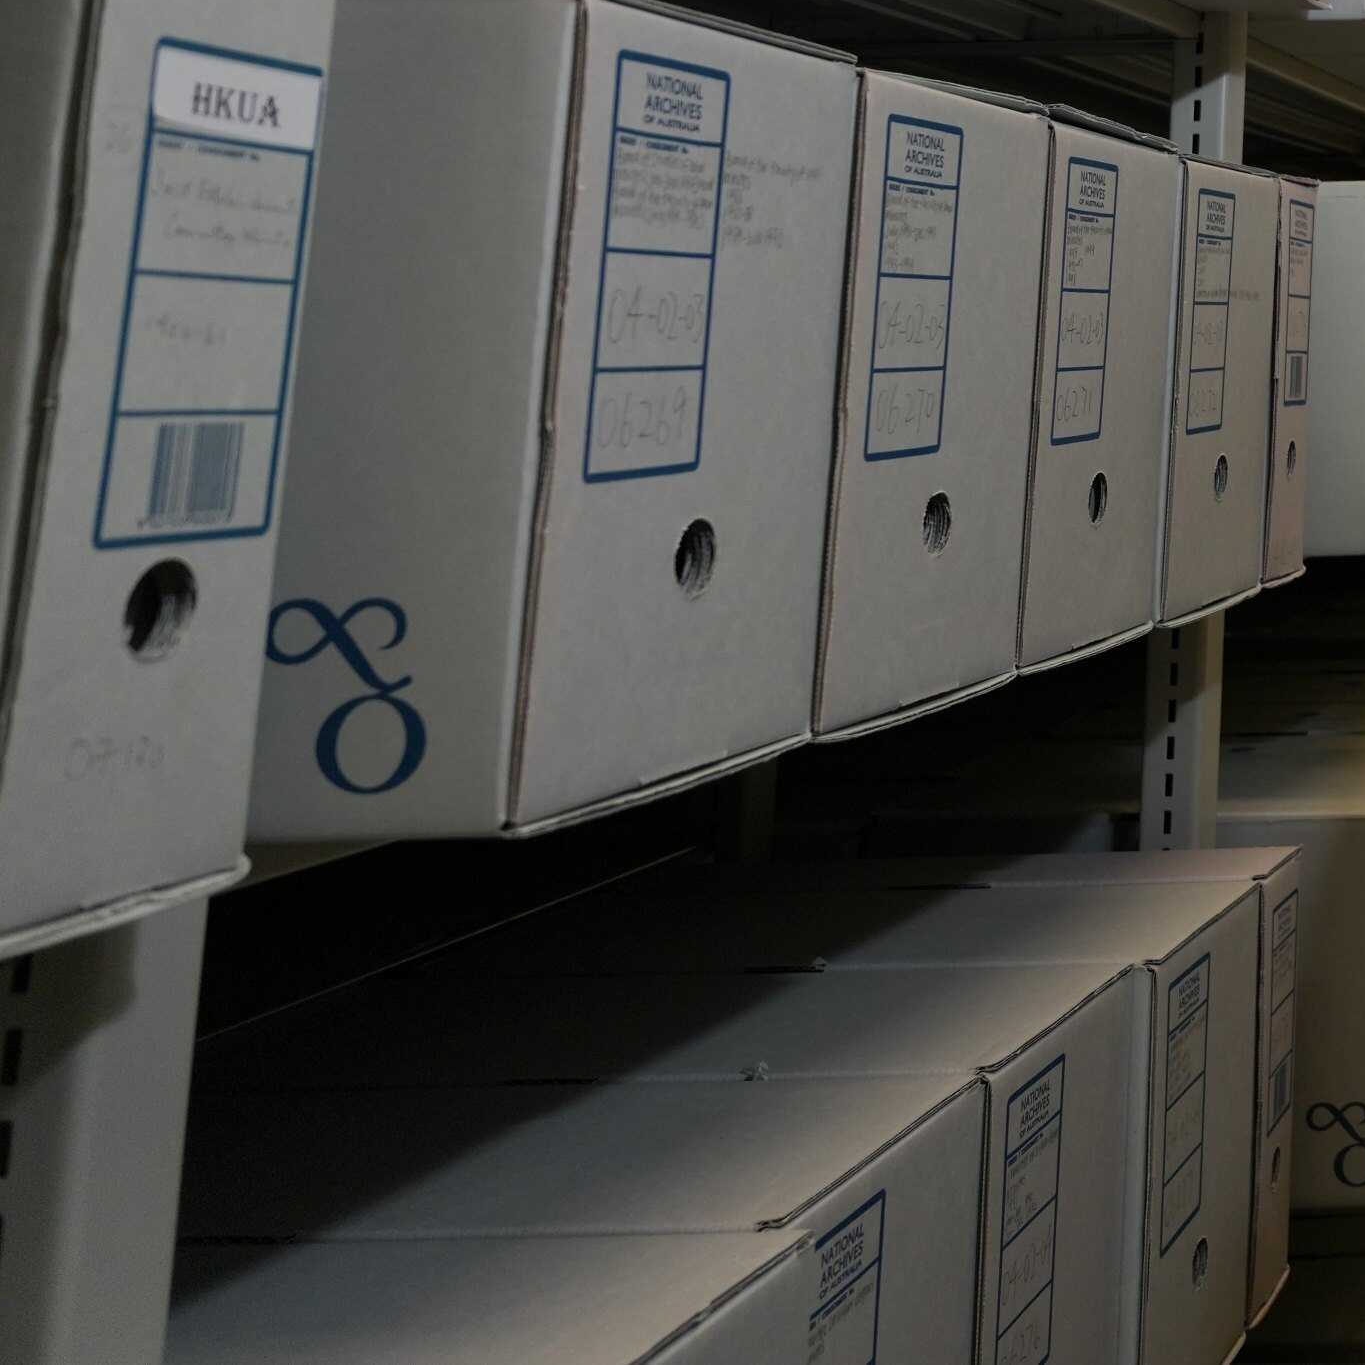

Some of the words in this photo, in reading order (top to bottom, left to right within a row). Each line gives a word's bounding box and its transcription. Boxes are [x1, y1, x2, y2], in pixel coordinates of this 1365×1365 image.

[645, 71, 704, 102] NATIONAL
[191, 81, 280, 128] HKUA
[643, 94, 704, 121] ARCHIVES
[906, 131, 946, 153] NATIONAL
[904, 148, 946, 169] ARCHIVES
[1079, 184, 1107, 201] ARCHIVES
[1080, 171, 1107, 186] NATIONAL
[607, 285, 704, 345] 04-02-03
[597, 385, 687, 450] 06269
[876, 384, 936, 435] 06270
[1020, 1079, 1051, 1112] NATIONAL
[1020, 1094, 1051, 1126] ARCHIVES
[820, 1222, 865, 1269] NATIONAL
[819, 1239, 864, 1289] ARCHIVES
